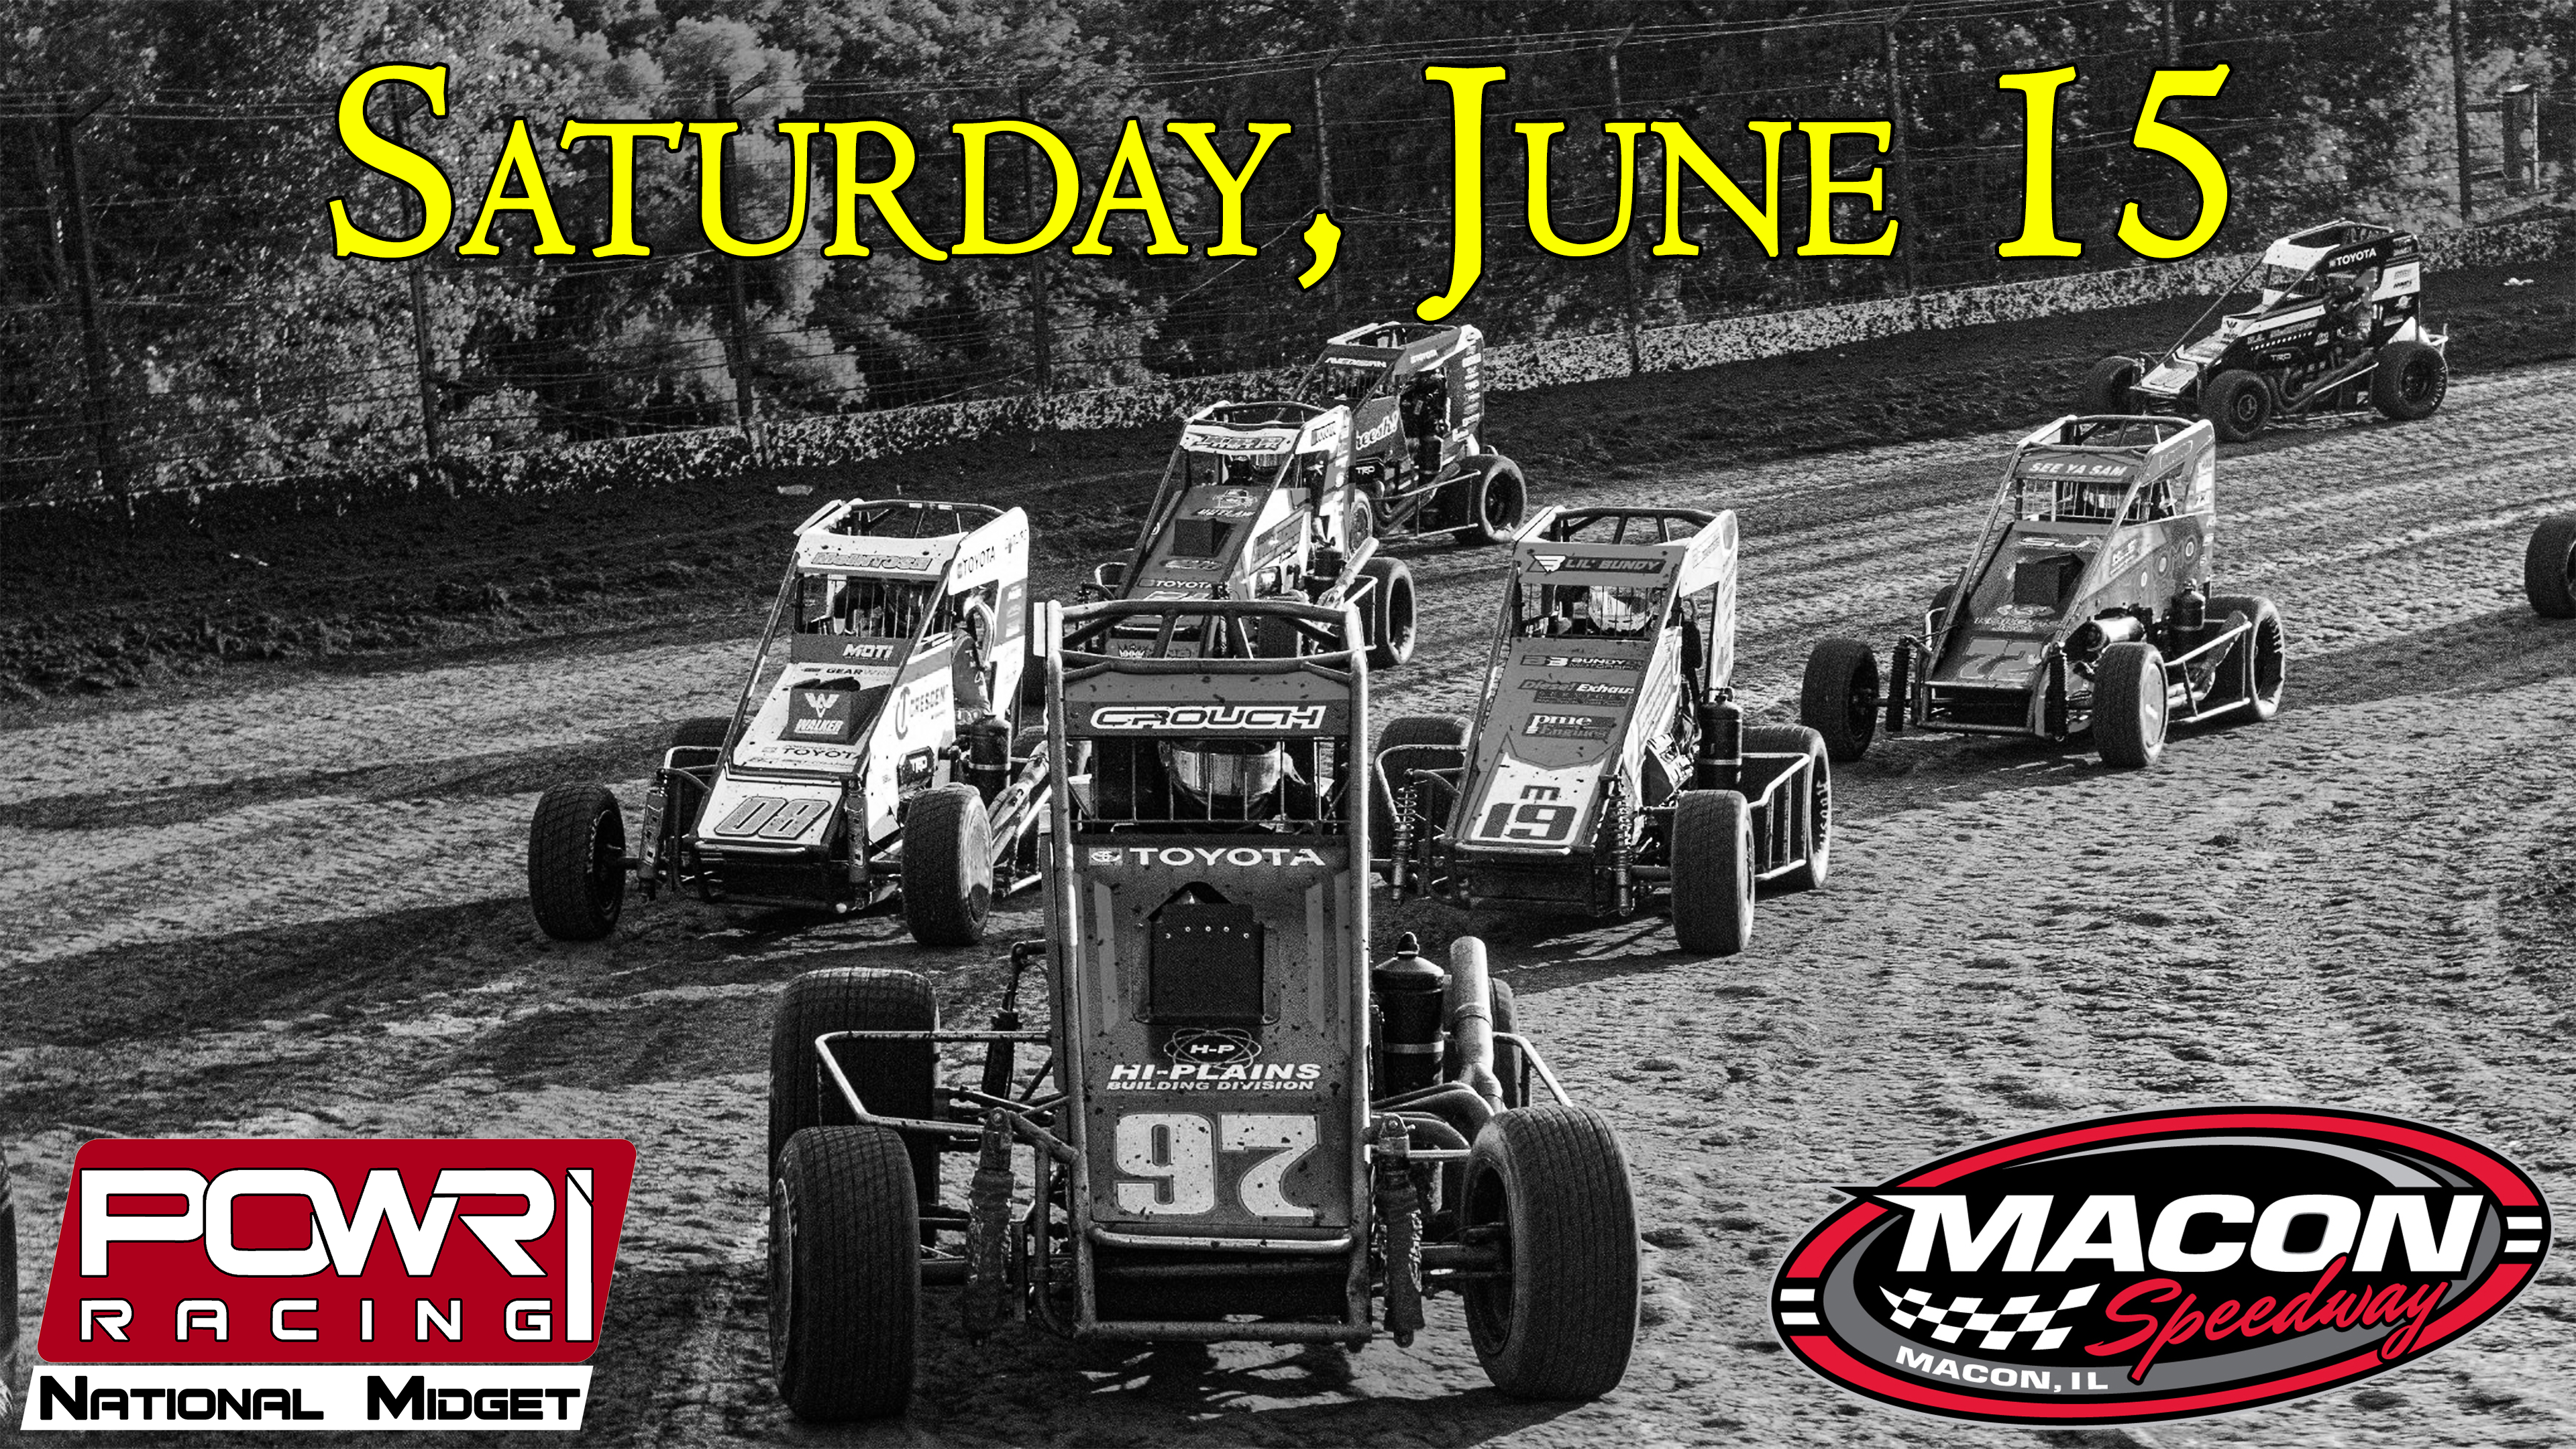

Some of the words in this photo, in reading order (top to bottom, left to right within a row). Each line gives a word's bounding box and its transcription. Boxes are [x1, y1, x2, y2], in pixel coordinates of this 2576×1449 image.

[2337, 248, 2376, 265] TOYOTA
[2029, 463, 2064, 473] SEE
[2065, 464, 2086, 474] YA
[2089, 466, 2128, 476] SAM
[963, 546, 996, 576] TOYOTA
[1565, 559, 1595, 569] LIL'
[1599, 560, 1660, 570] BUNDY
[1571, 657, 1626, 665] BUNDY
[1576, 684, 1635, 694] Exhaus
[1091, 706, 1326, 729] CROUCH
[794, 718, 843, 733] WALKER
[784, 748, 861, 760] TOYOT
[1479, 802, 1576, 841] 19
[1129, 848, 1326, 866] TOYOTA
[1190, 1044, 1235, 1053] H-P
[1110, 1063, 1320, 1080] HI-PLAINS
[1106, 1081, 1210, 1091] BUILDING
[1217, 1081, 1315, 1091] DIVISION
[1116, 1114, 1319, 1217] 97
